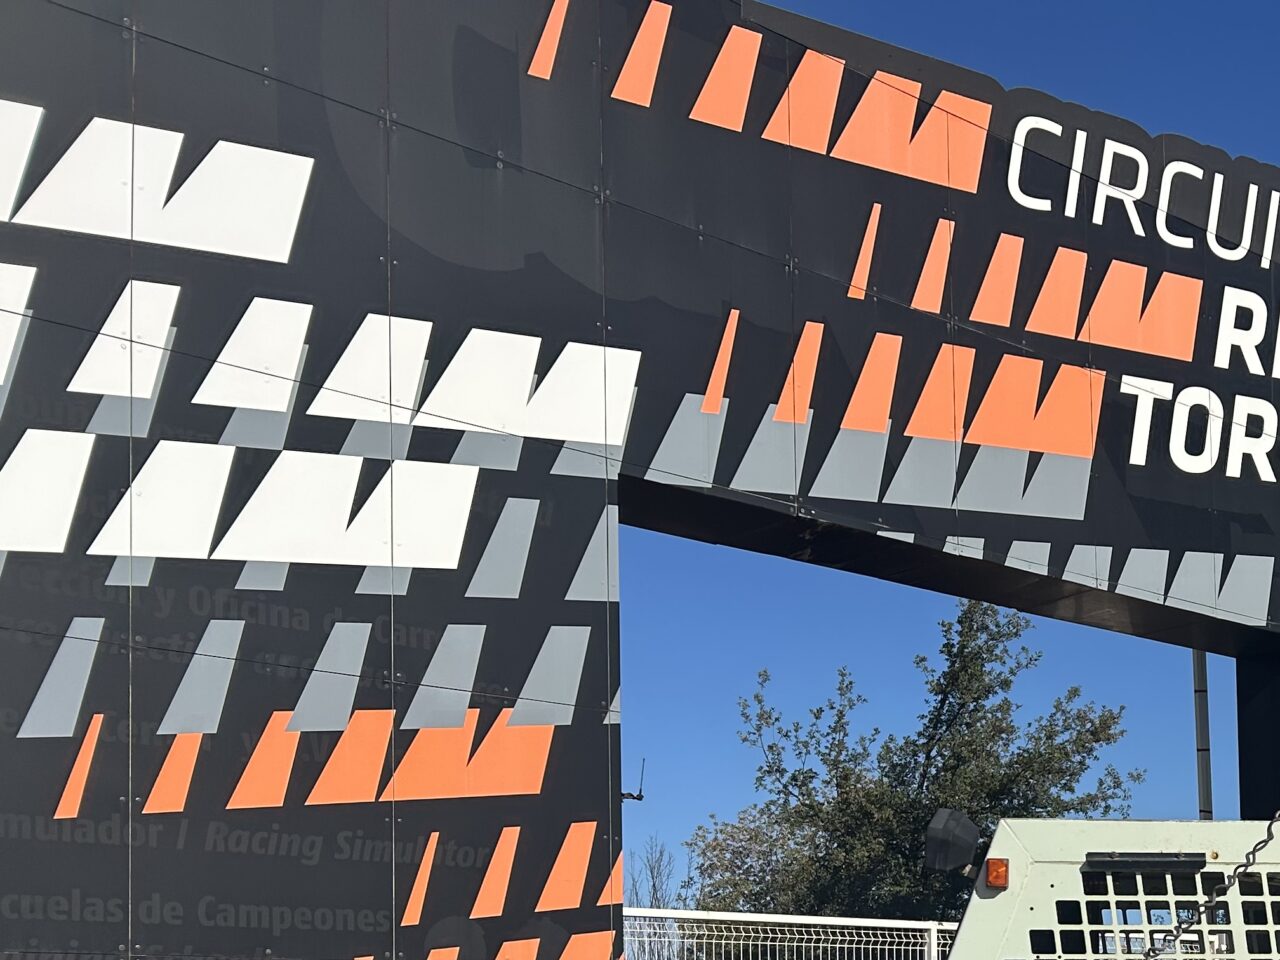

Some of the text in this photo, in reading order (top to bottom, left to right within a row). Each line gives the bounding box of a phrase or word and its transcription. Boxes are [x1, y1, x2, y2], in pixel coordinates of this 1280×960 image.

[205, 821, 323, 866] Racing
[139, 893, 184, 926] de
[198, 896, 390, 936] Campeones
